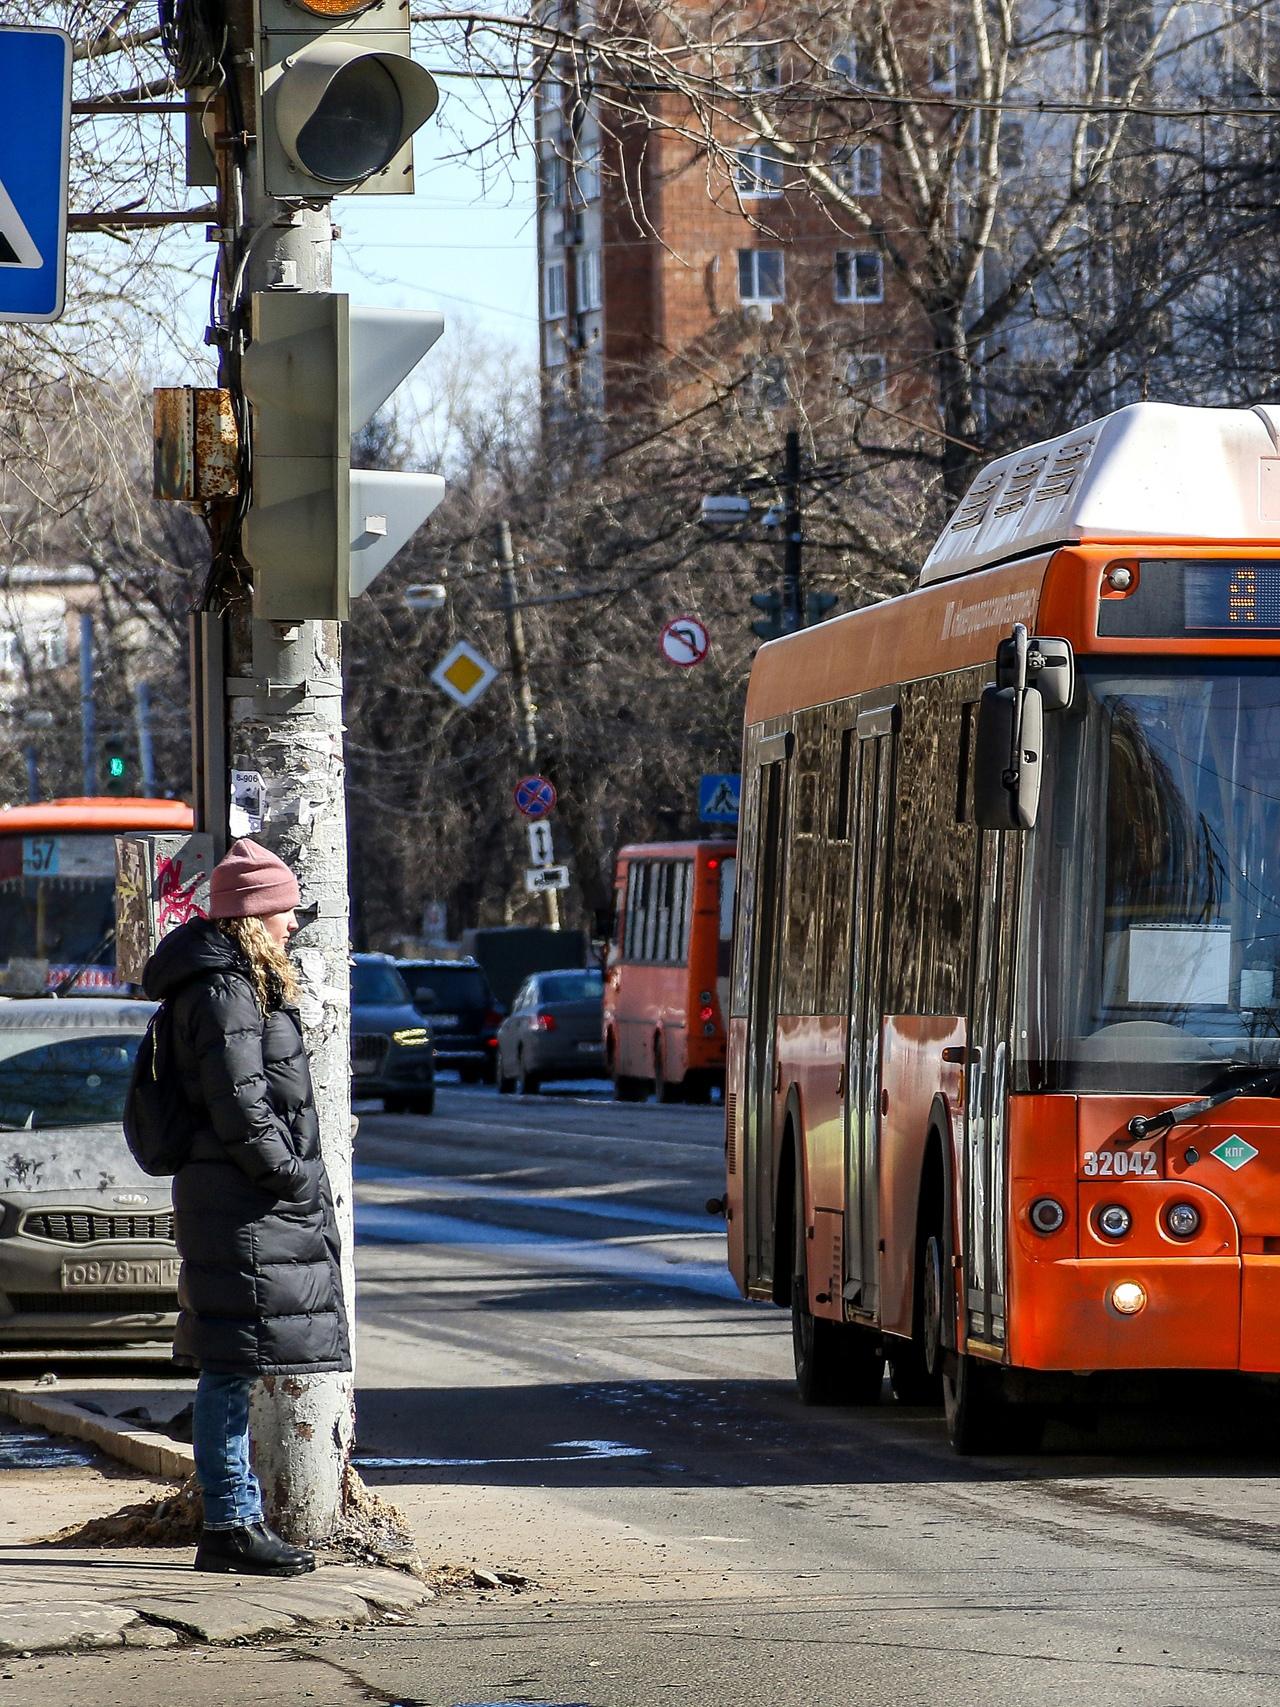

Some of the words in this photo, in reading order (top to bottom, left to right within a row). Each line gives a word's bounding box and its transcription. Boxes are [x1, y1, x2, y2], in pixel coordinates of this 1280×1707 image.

[1224, 1147, 1245, 1158] КПГ
[1083, 1151, 1158, 1176] 32042
[117, 1194, 143, 1204] KIA
